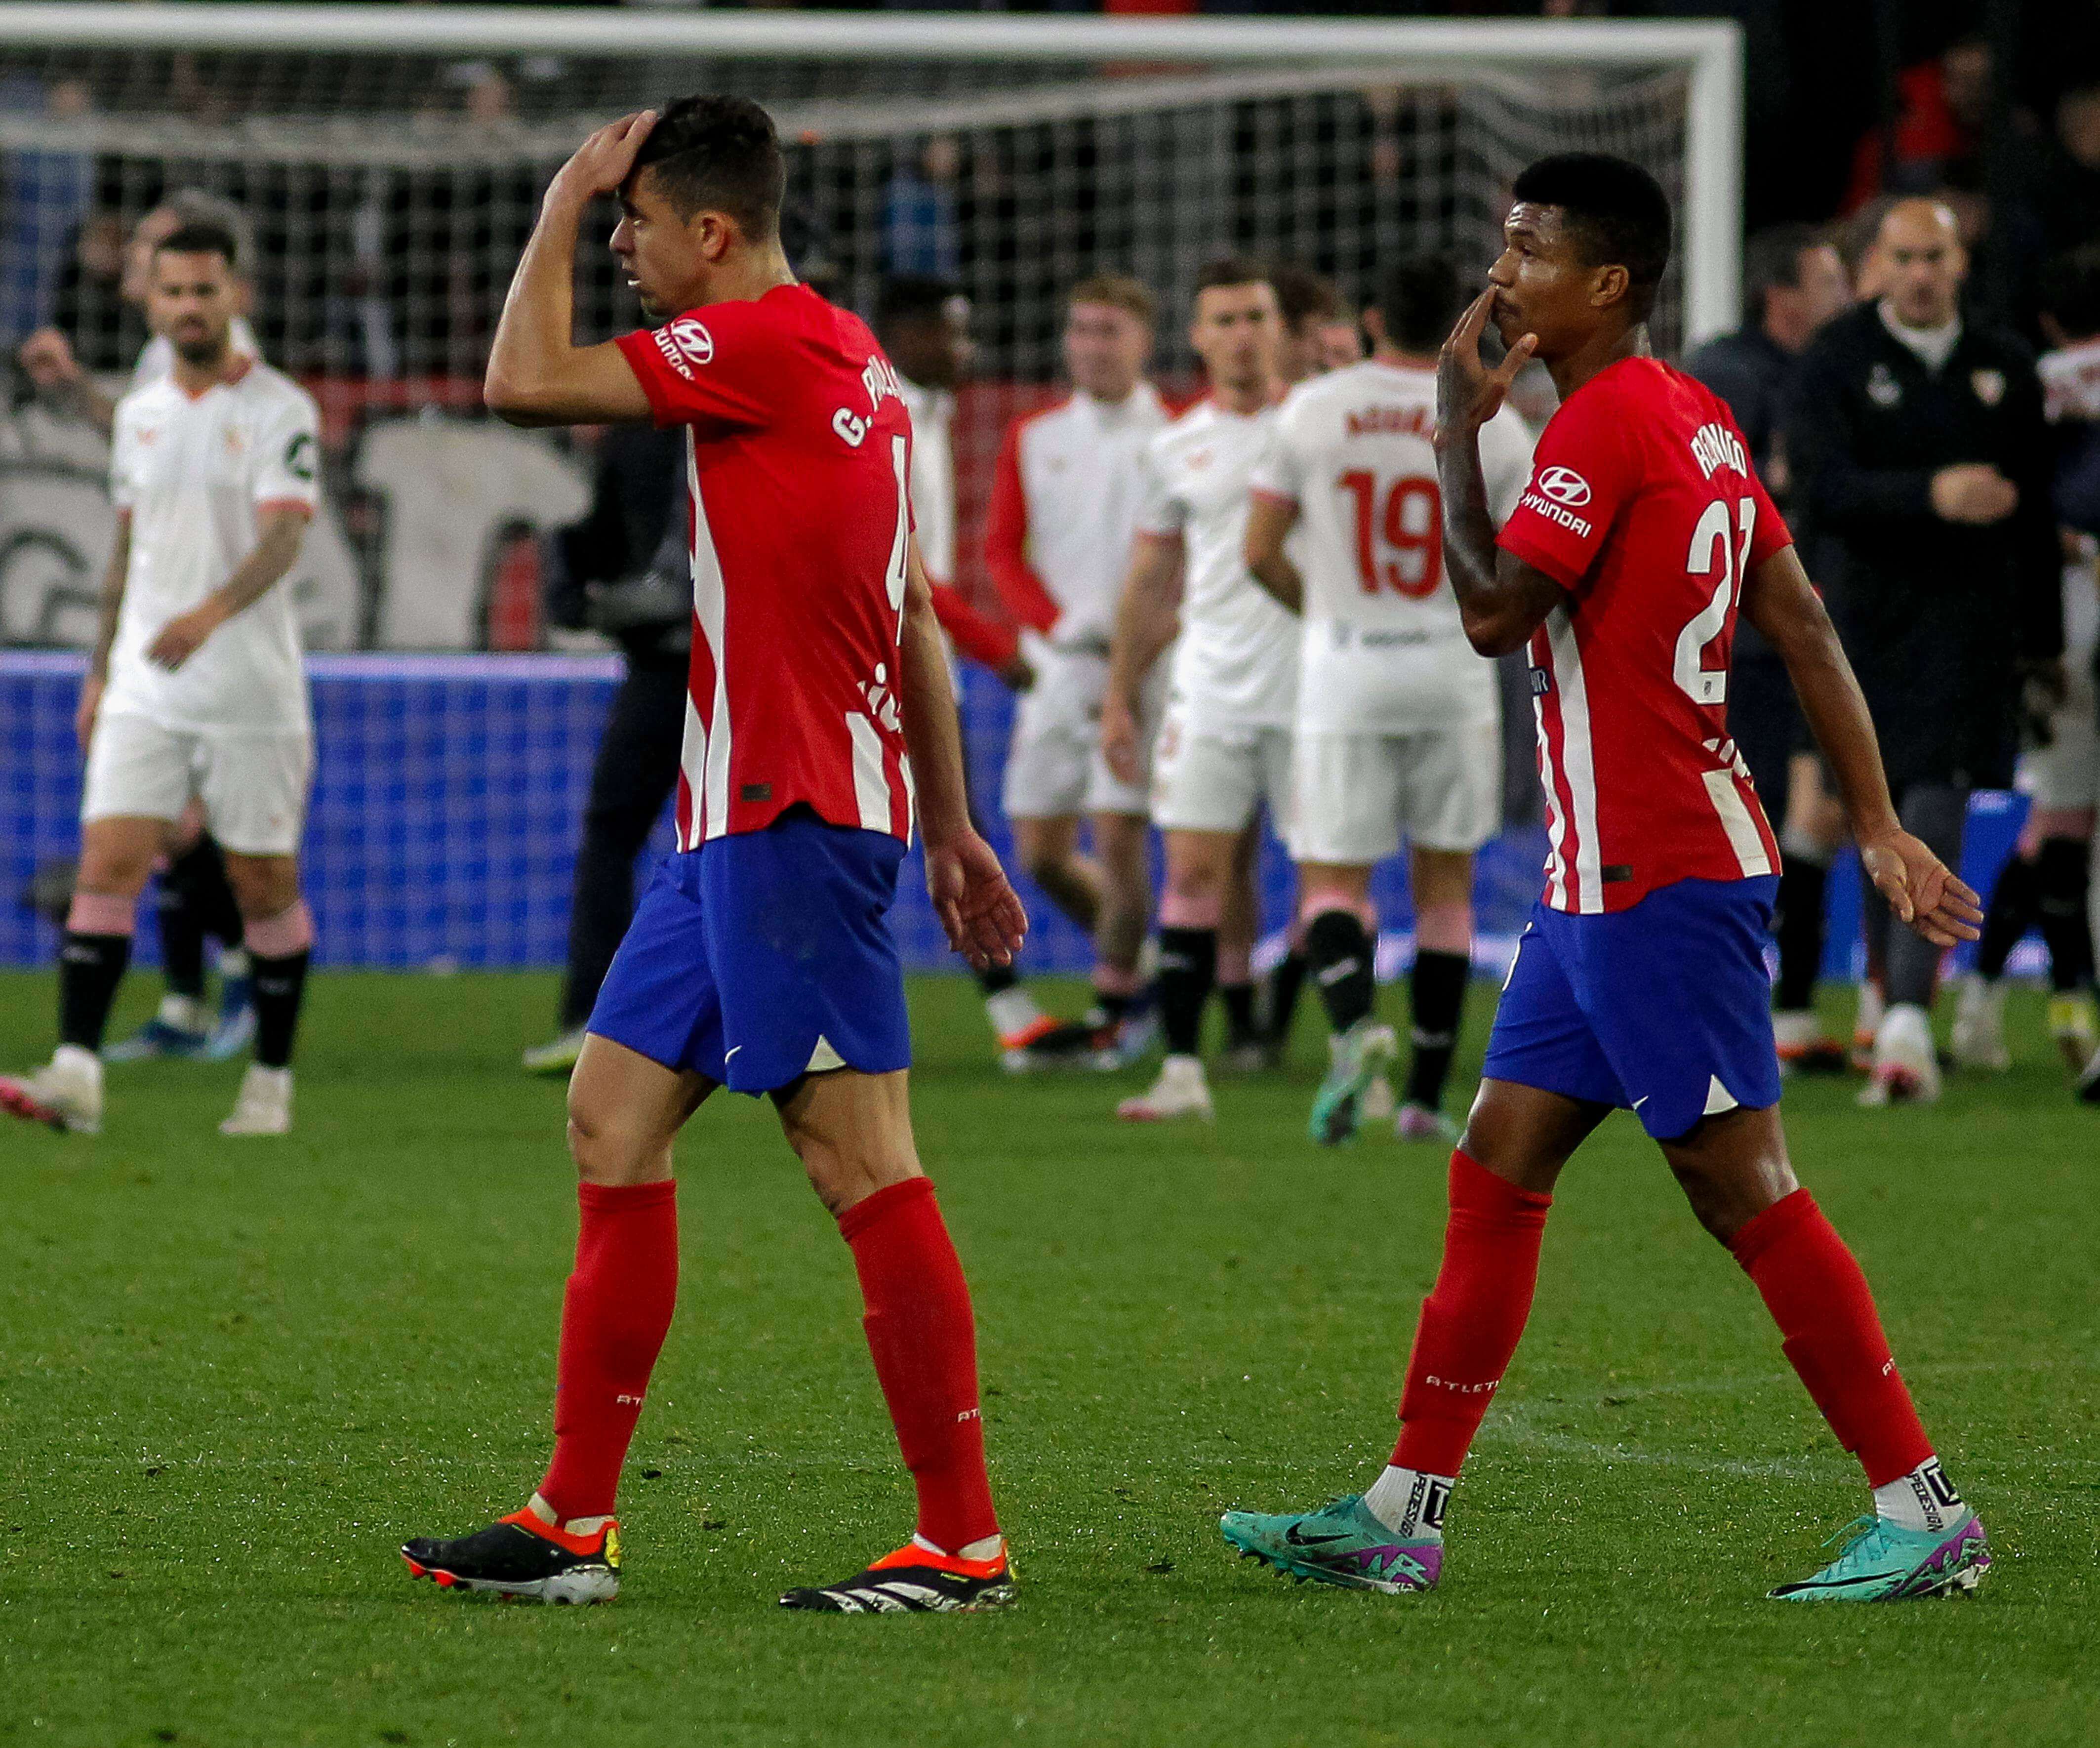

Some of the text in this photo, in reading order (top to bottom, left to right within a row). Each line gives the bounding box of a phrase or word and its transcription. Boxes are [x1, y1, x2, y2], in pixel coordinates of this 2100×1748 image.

[832, 407, 874, 448] G.
[1334, 467, 1443, 599] 19
[1521, 492, 1592, 538] HYUNDAI
